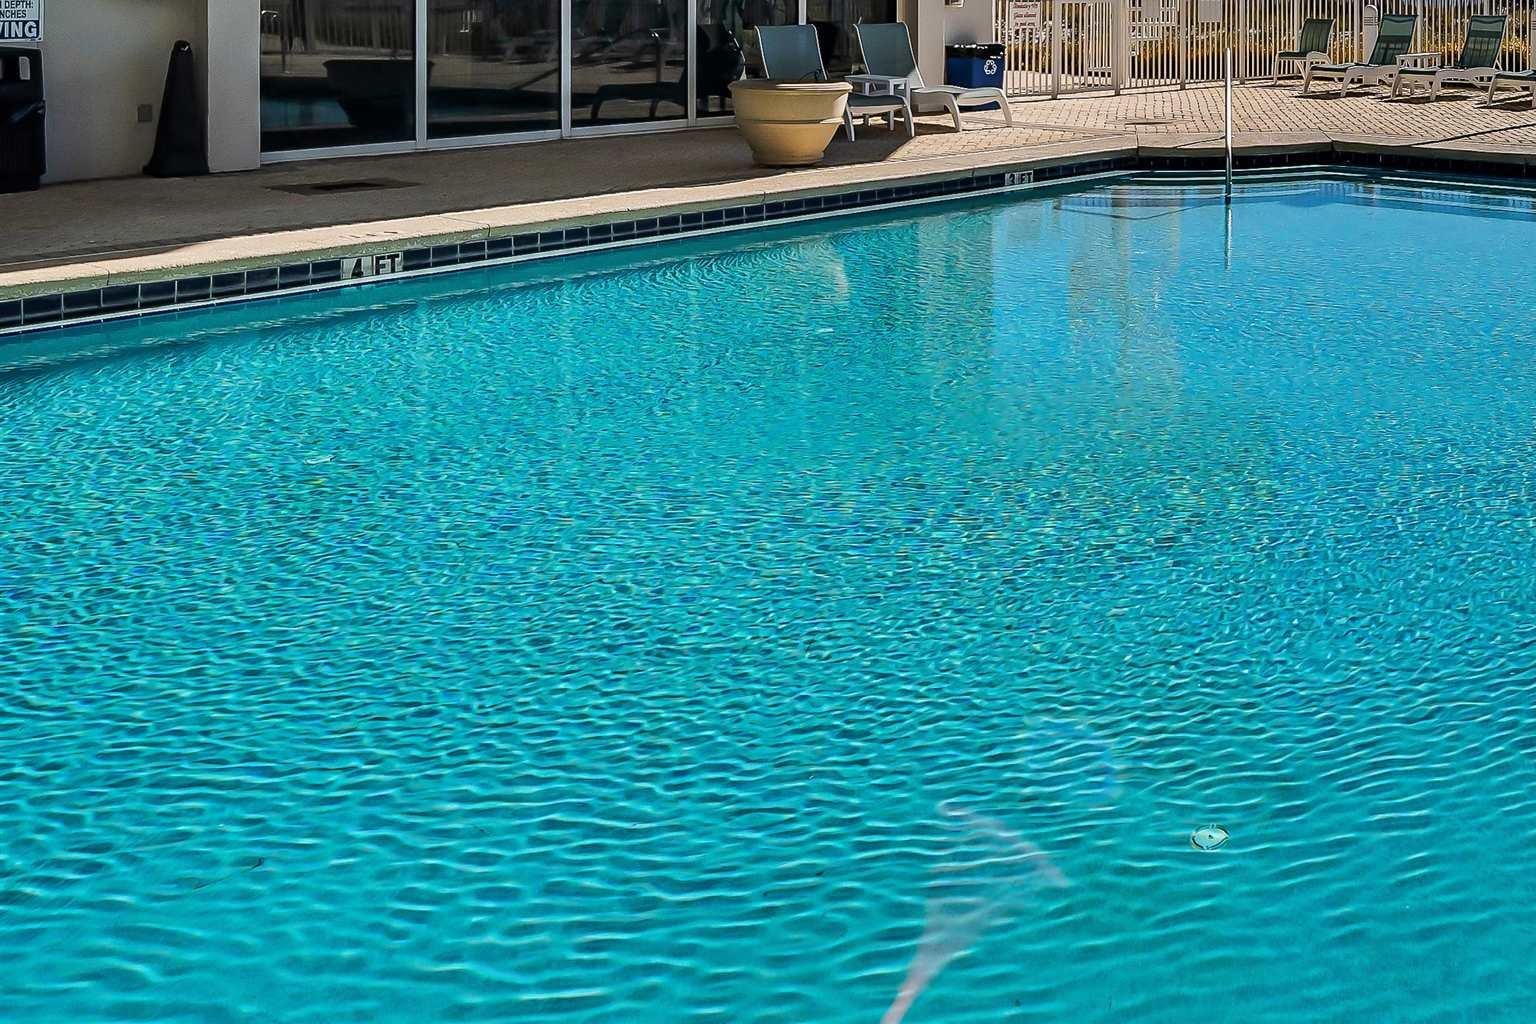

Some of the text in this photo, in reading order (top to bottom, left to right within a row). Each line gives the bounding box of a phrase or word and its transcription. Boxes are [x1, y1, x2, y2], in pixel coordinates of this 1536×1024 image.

[5, 0, 33, 9] DEPTH:
[0, 21, 37, 37] ING
[376, 253, 400, 275] FT
